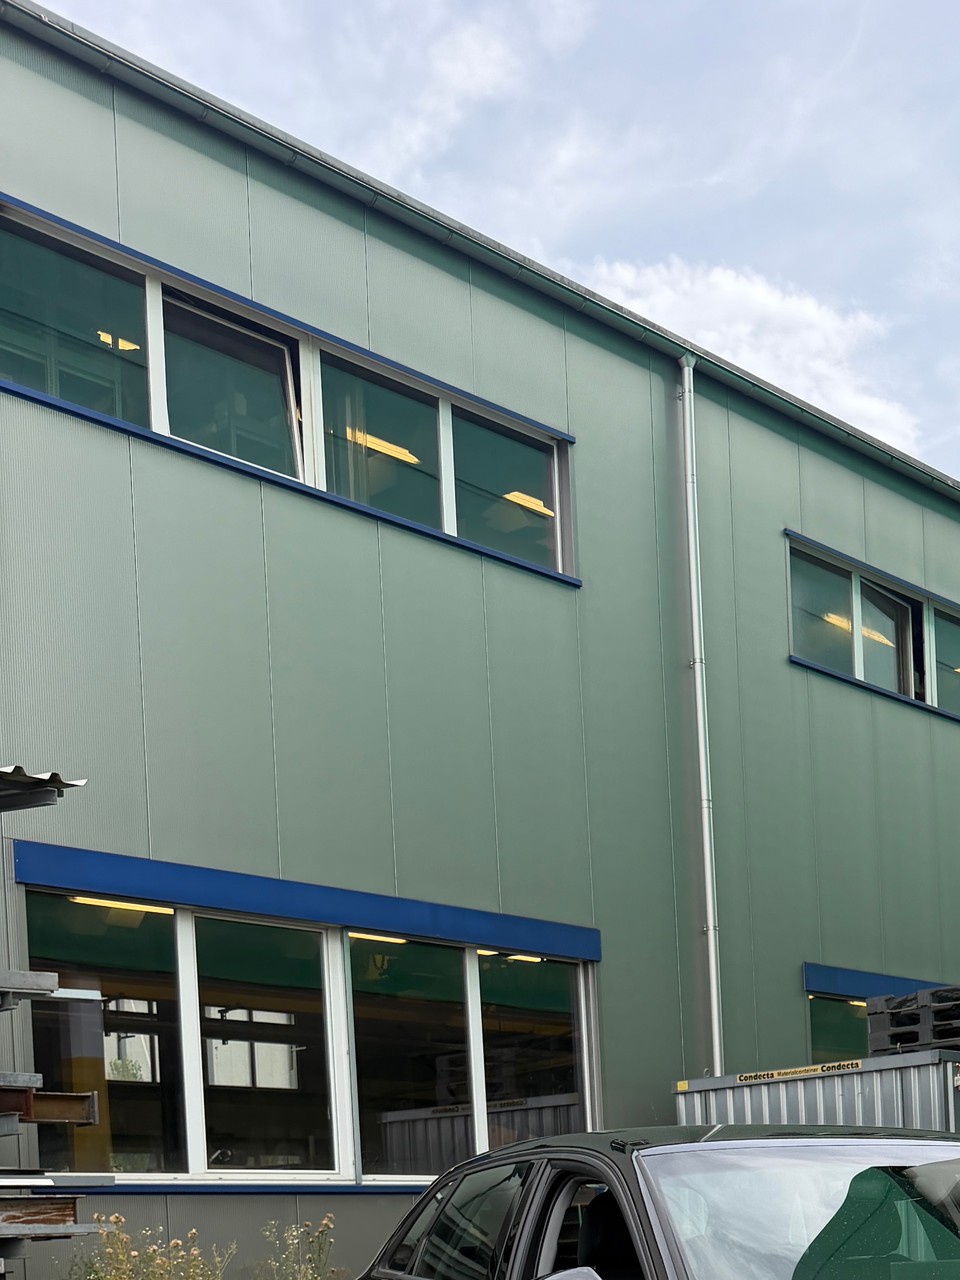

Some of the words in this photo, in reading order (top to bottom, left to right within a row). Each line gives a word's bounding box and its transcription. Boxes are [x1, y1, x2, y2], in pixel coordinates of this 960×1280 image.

[738, 1072, 774, 1082] Condecta
[777, 1067, 819, 1077] Materialcontainer
[820, 1061, 859, 1073] Condecta
